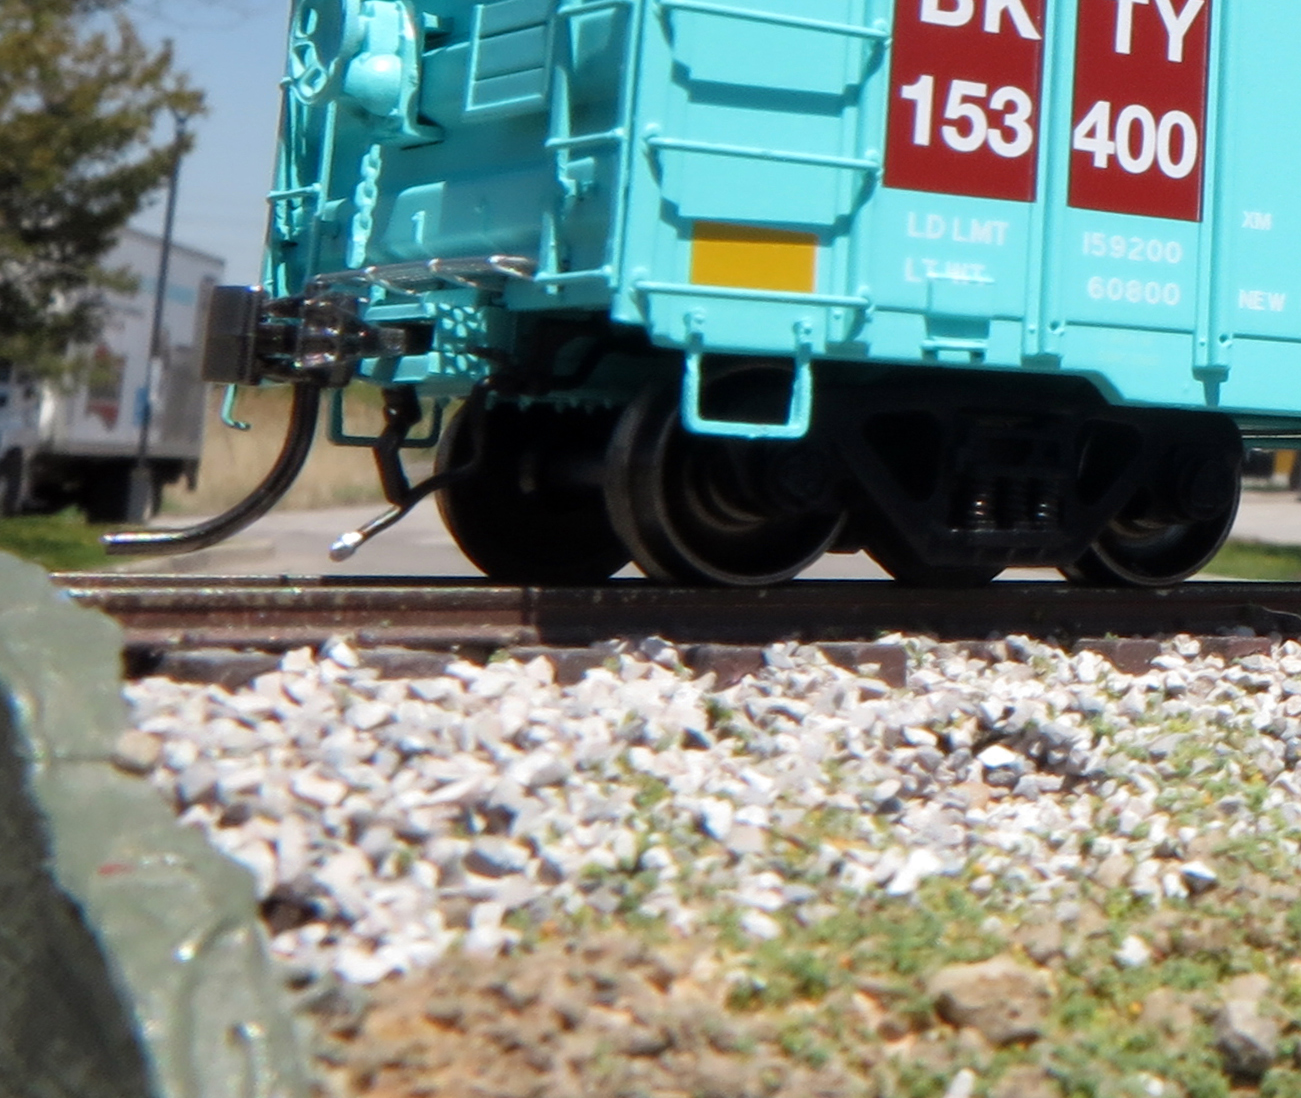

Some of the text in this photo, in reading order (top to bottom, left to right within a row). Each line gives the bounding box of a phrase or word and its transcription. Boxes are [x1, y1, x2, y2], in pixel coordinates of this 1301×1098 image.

[901, 75, 1199, 180] 153 400
[907, 211, 1183, 264] LD LMT 159200
[1087, 276, 1181, 306] 60800
[1238, 289, 1286, 312] NEW
